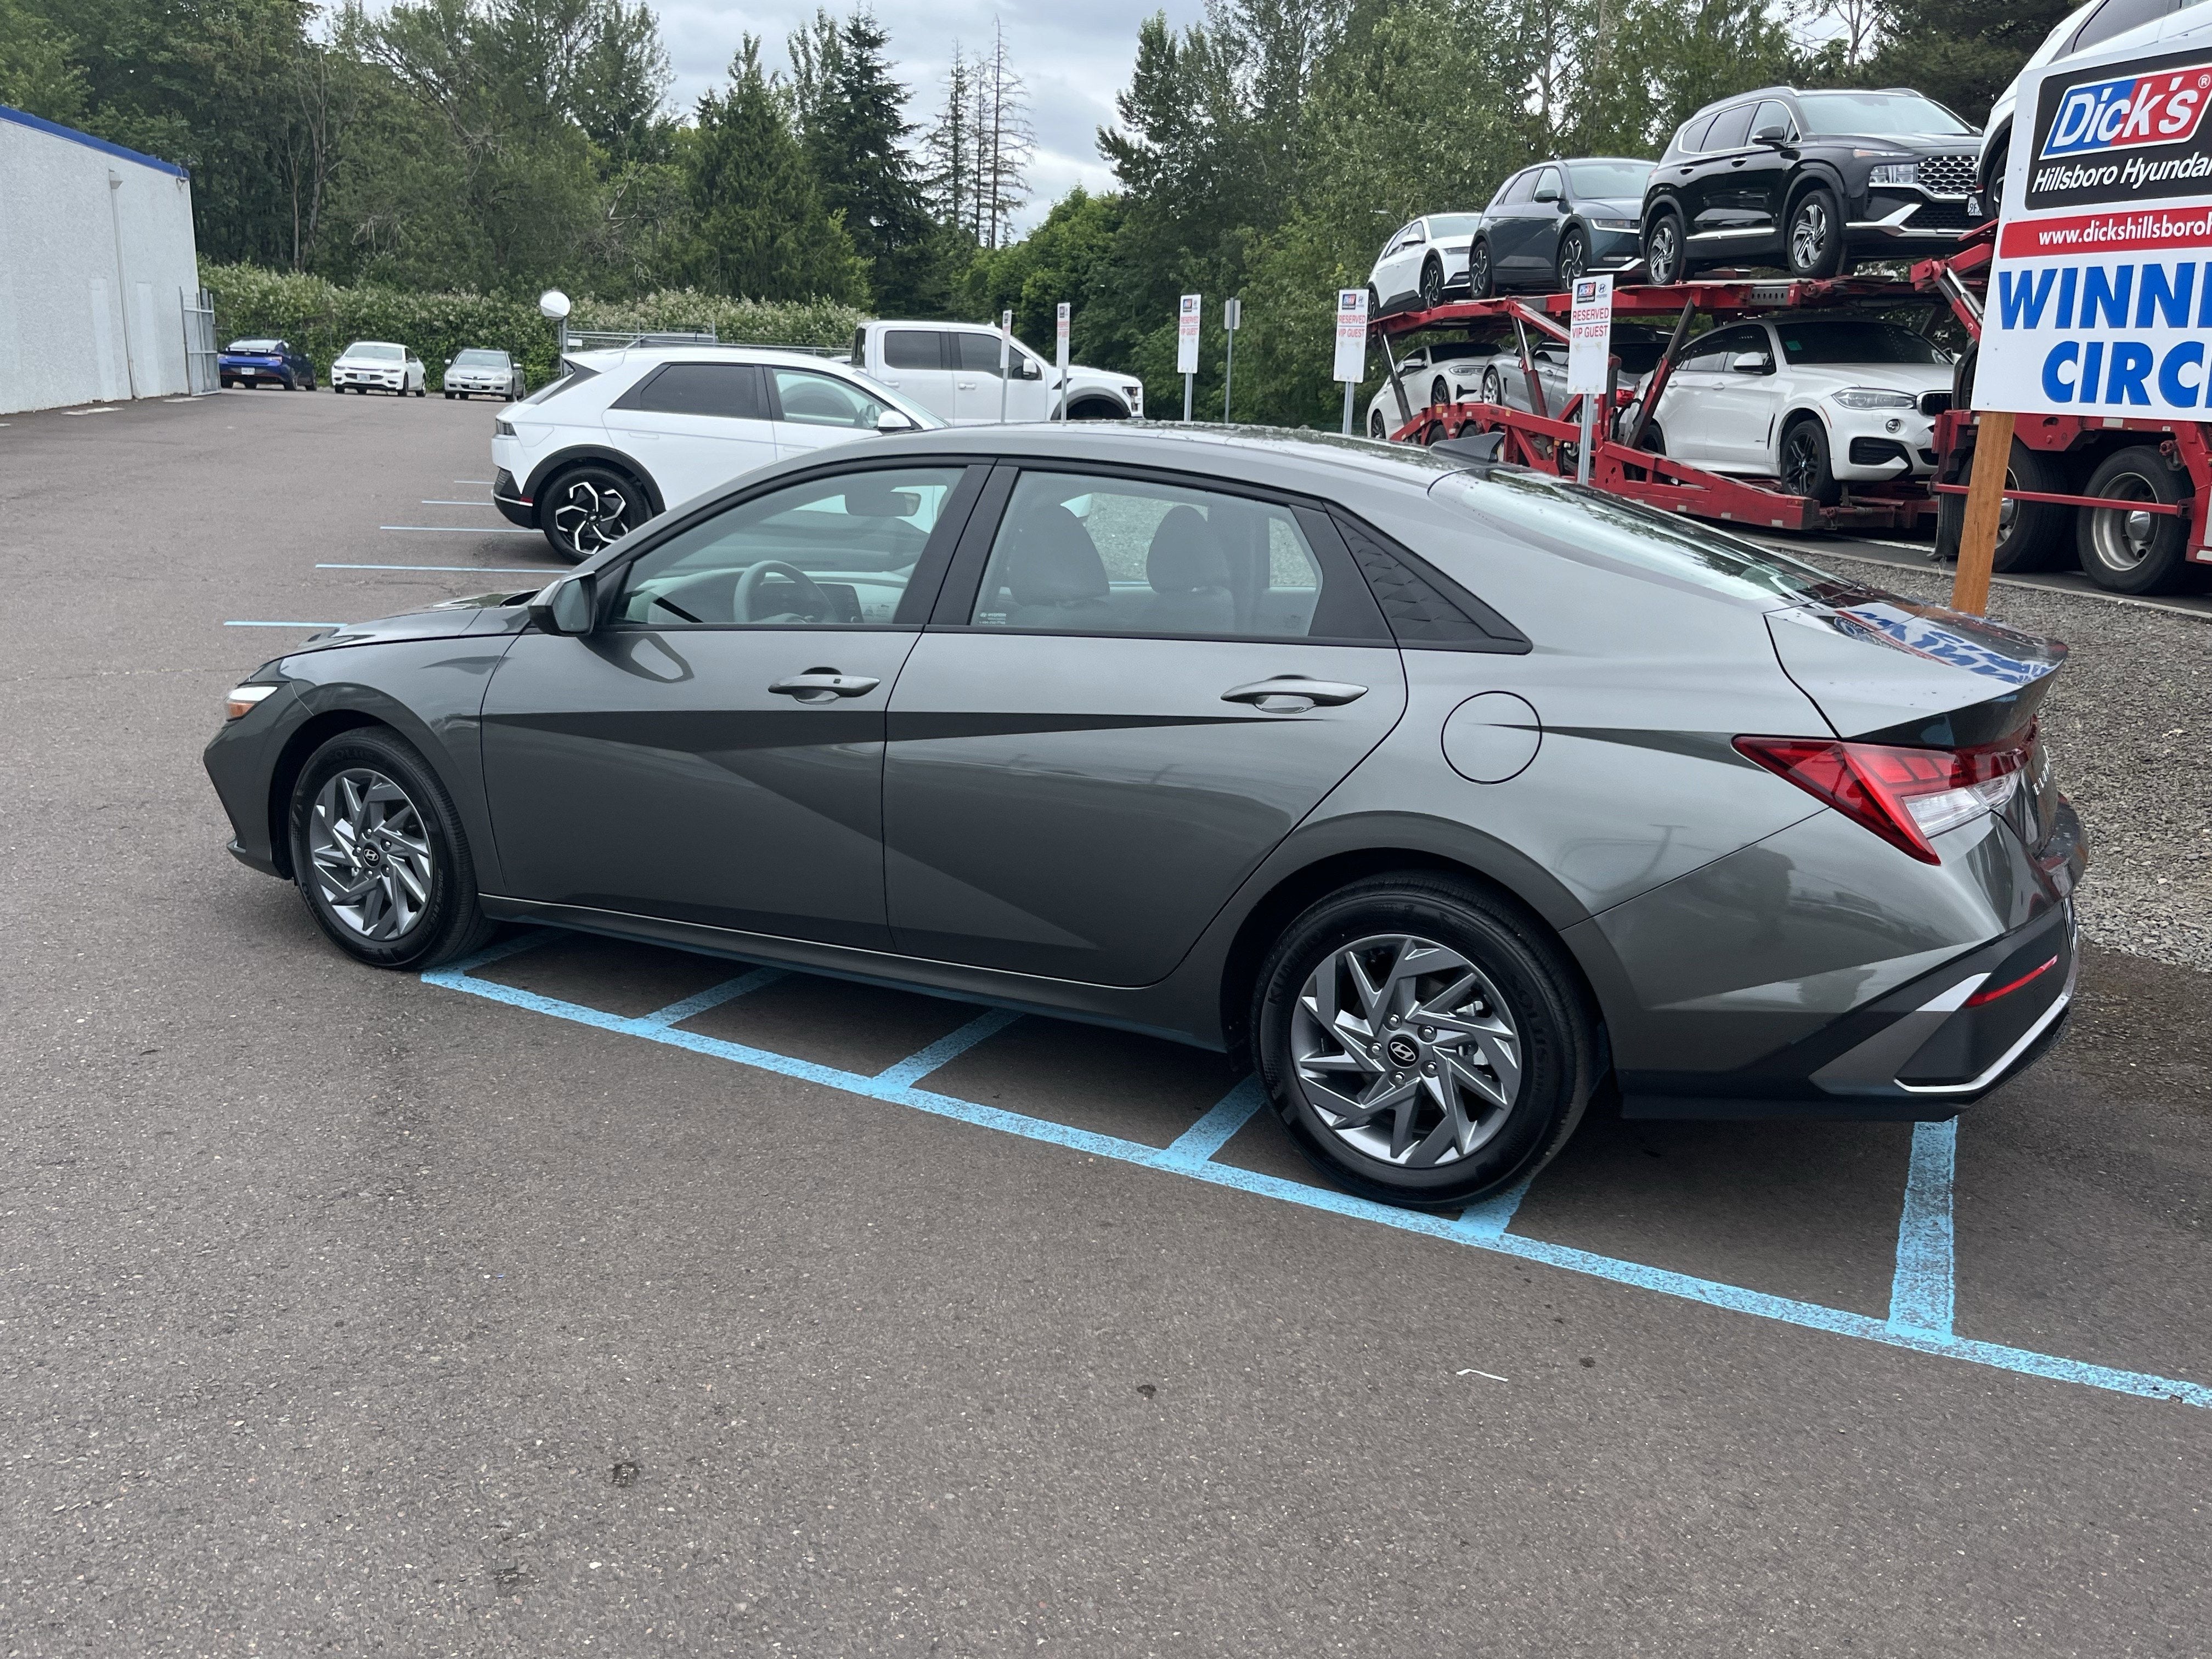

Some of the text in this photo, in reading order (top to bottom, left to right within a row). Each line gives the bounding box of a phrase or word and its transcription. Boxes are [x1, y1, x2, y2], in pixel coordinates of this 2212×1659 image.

[2052, 76, 2199, 148] Dick's
[2031, 164, 2118, 193] Hillsboro
[1339, 315, 1366, 324] RESERVED
[1572, 308, 1609, 321] RESERVED
[1347, 329, 1365, 337] GUEST
[1572, 325, 1608, 338] VIP GUEST
